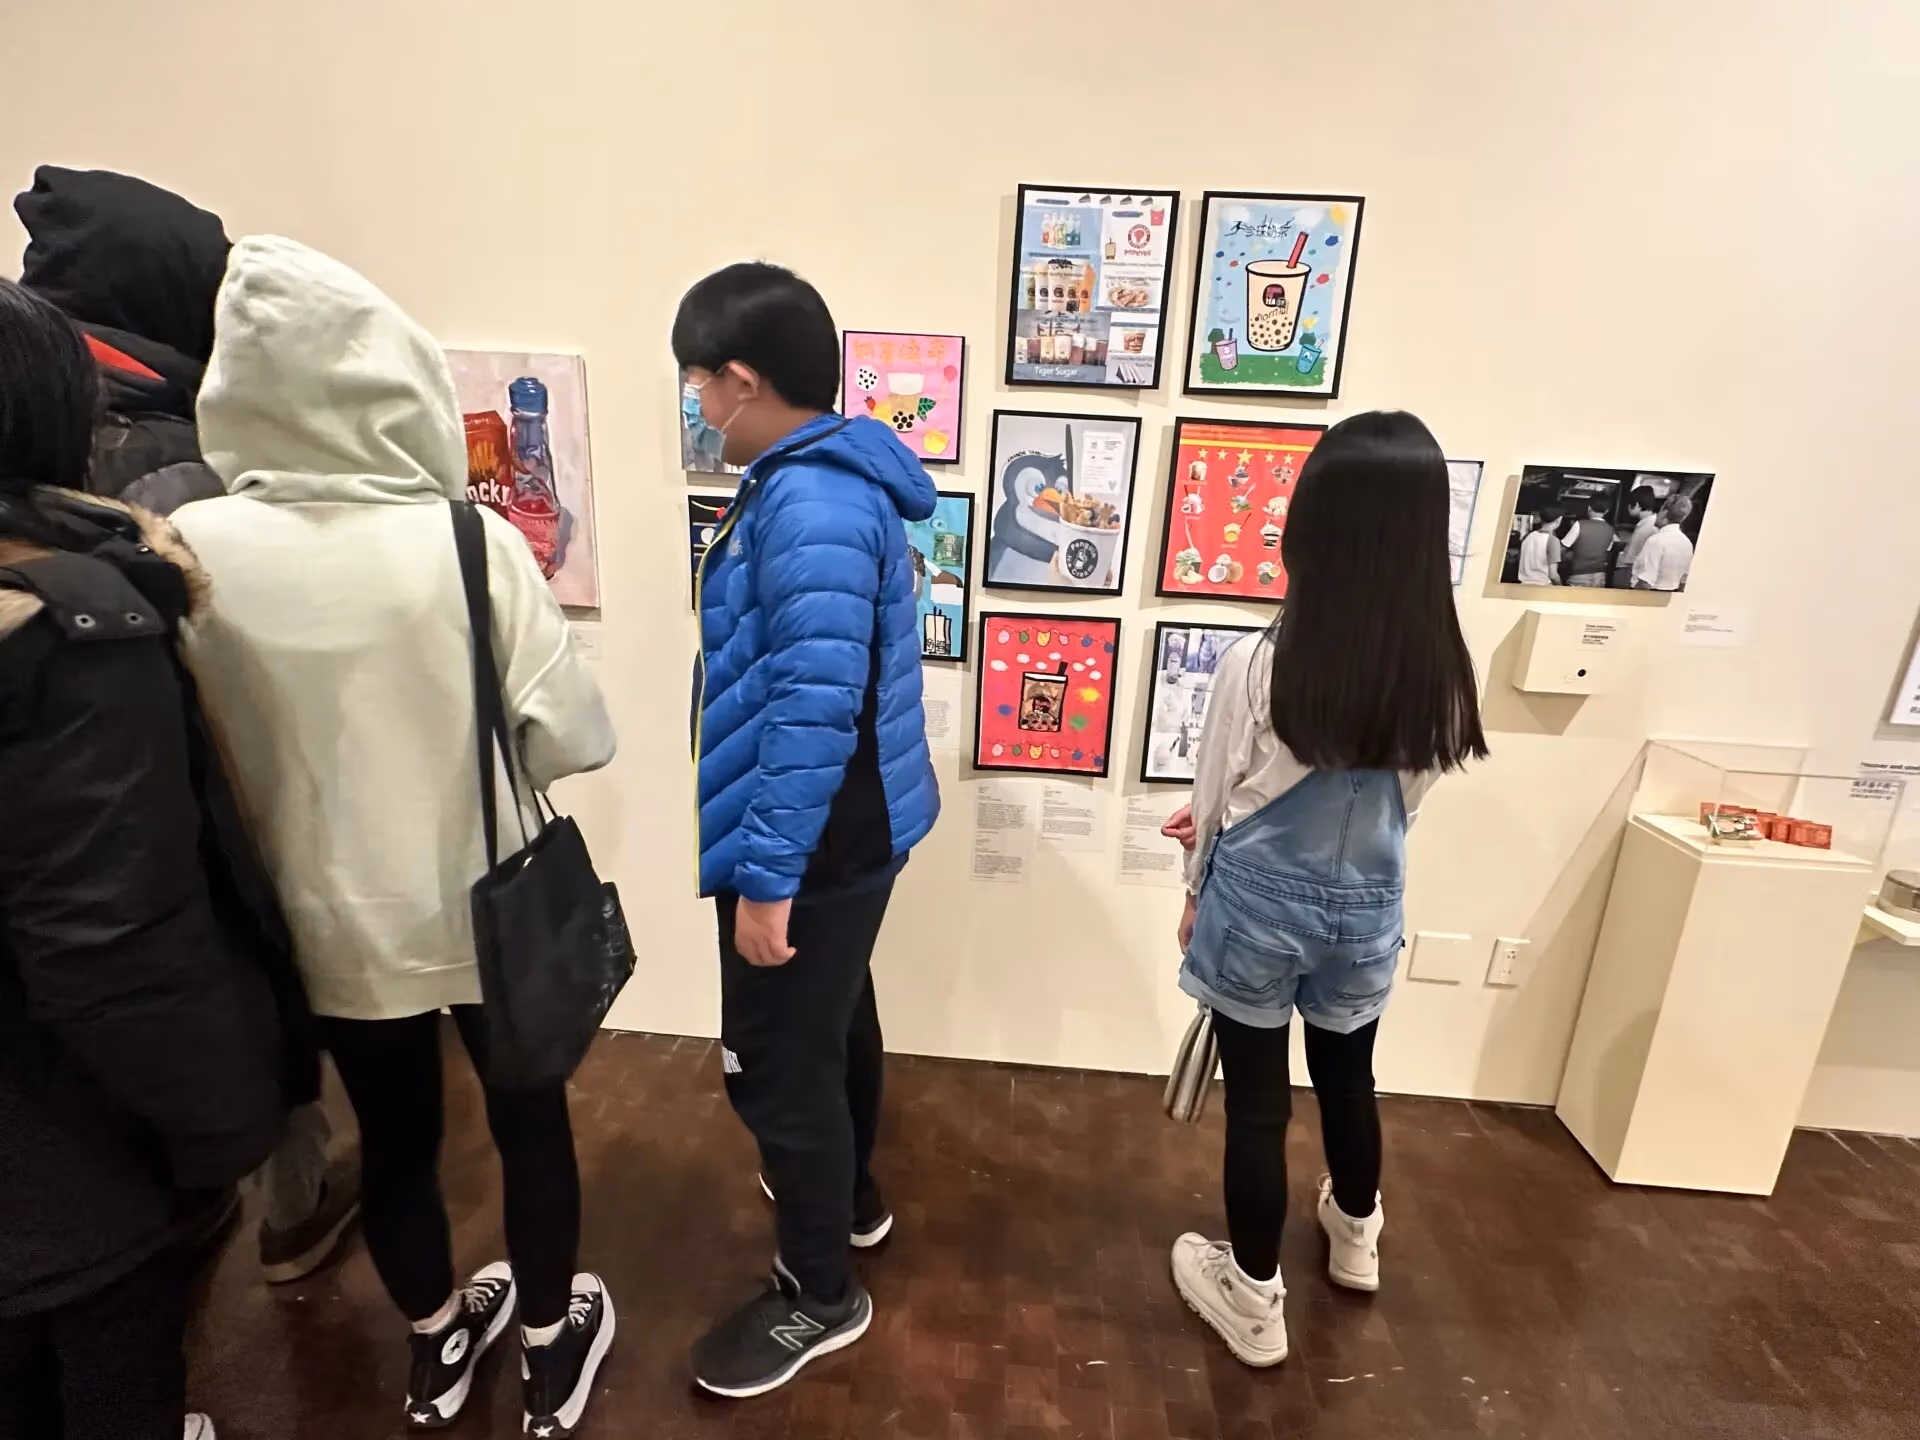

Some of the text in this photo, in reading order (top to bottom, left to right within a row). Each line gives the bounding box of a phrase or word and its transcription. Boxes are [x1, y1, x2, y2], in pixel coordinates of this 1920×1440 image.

[1034, 365, 1079, 378] Tiger Sugar
[464, 477, 513, 507] ocky
[1070, 541, 1097, 559] Penguin
[1071, 564, 1095, 578] Cream
